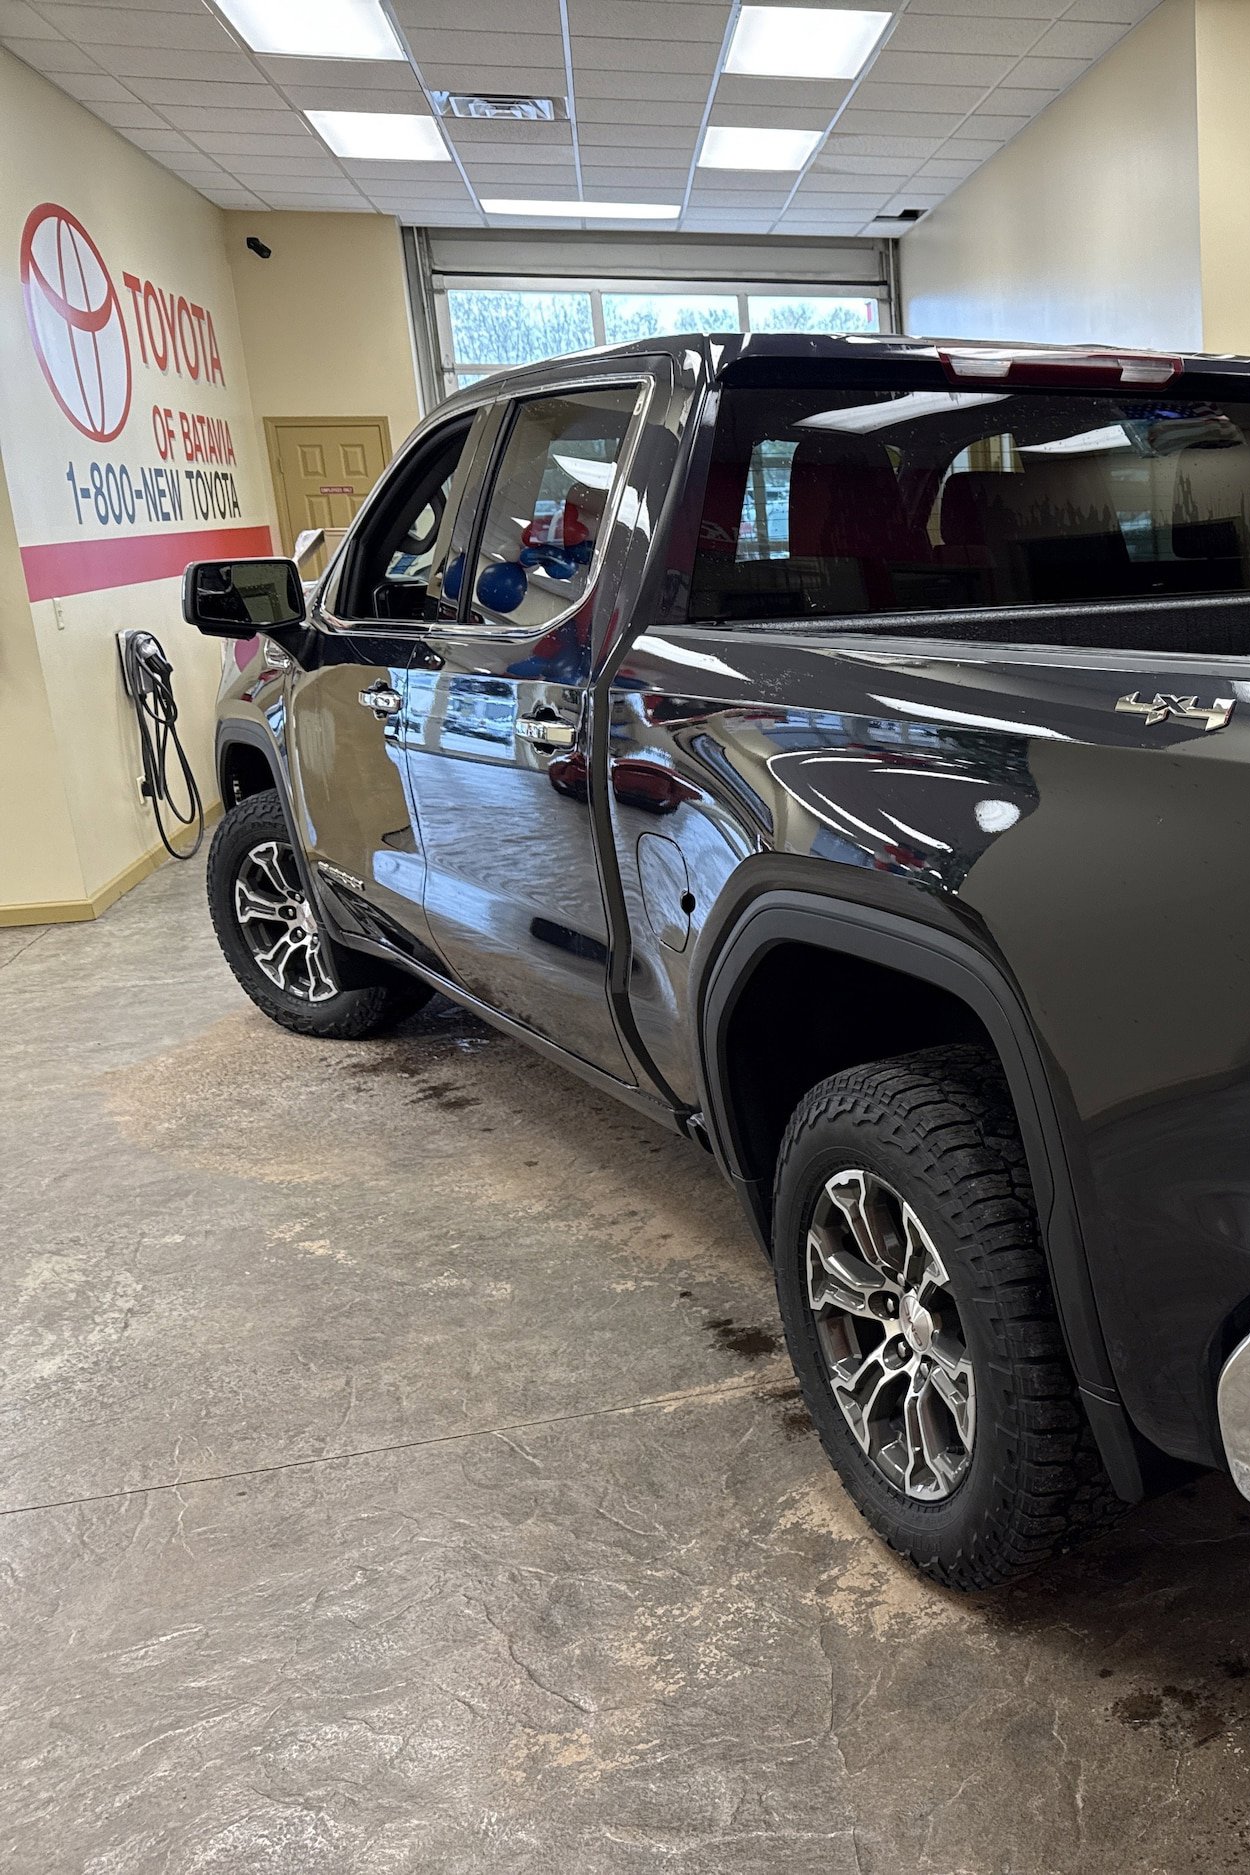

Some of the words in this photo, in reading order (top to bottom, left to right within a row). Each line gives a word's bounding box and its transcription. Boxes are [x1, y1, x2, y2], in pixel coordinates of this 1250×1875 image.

[123, 271, 225, 387] TOYOTA
[153, 405, 174, 460] OF
[179, 411, 236, 466] BATAVIA
[67, 461, 183, 525] 1-800-NEW
[185, 470, 241, 520] TOYOTA
